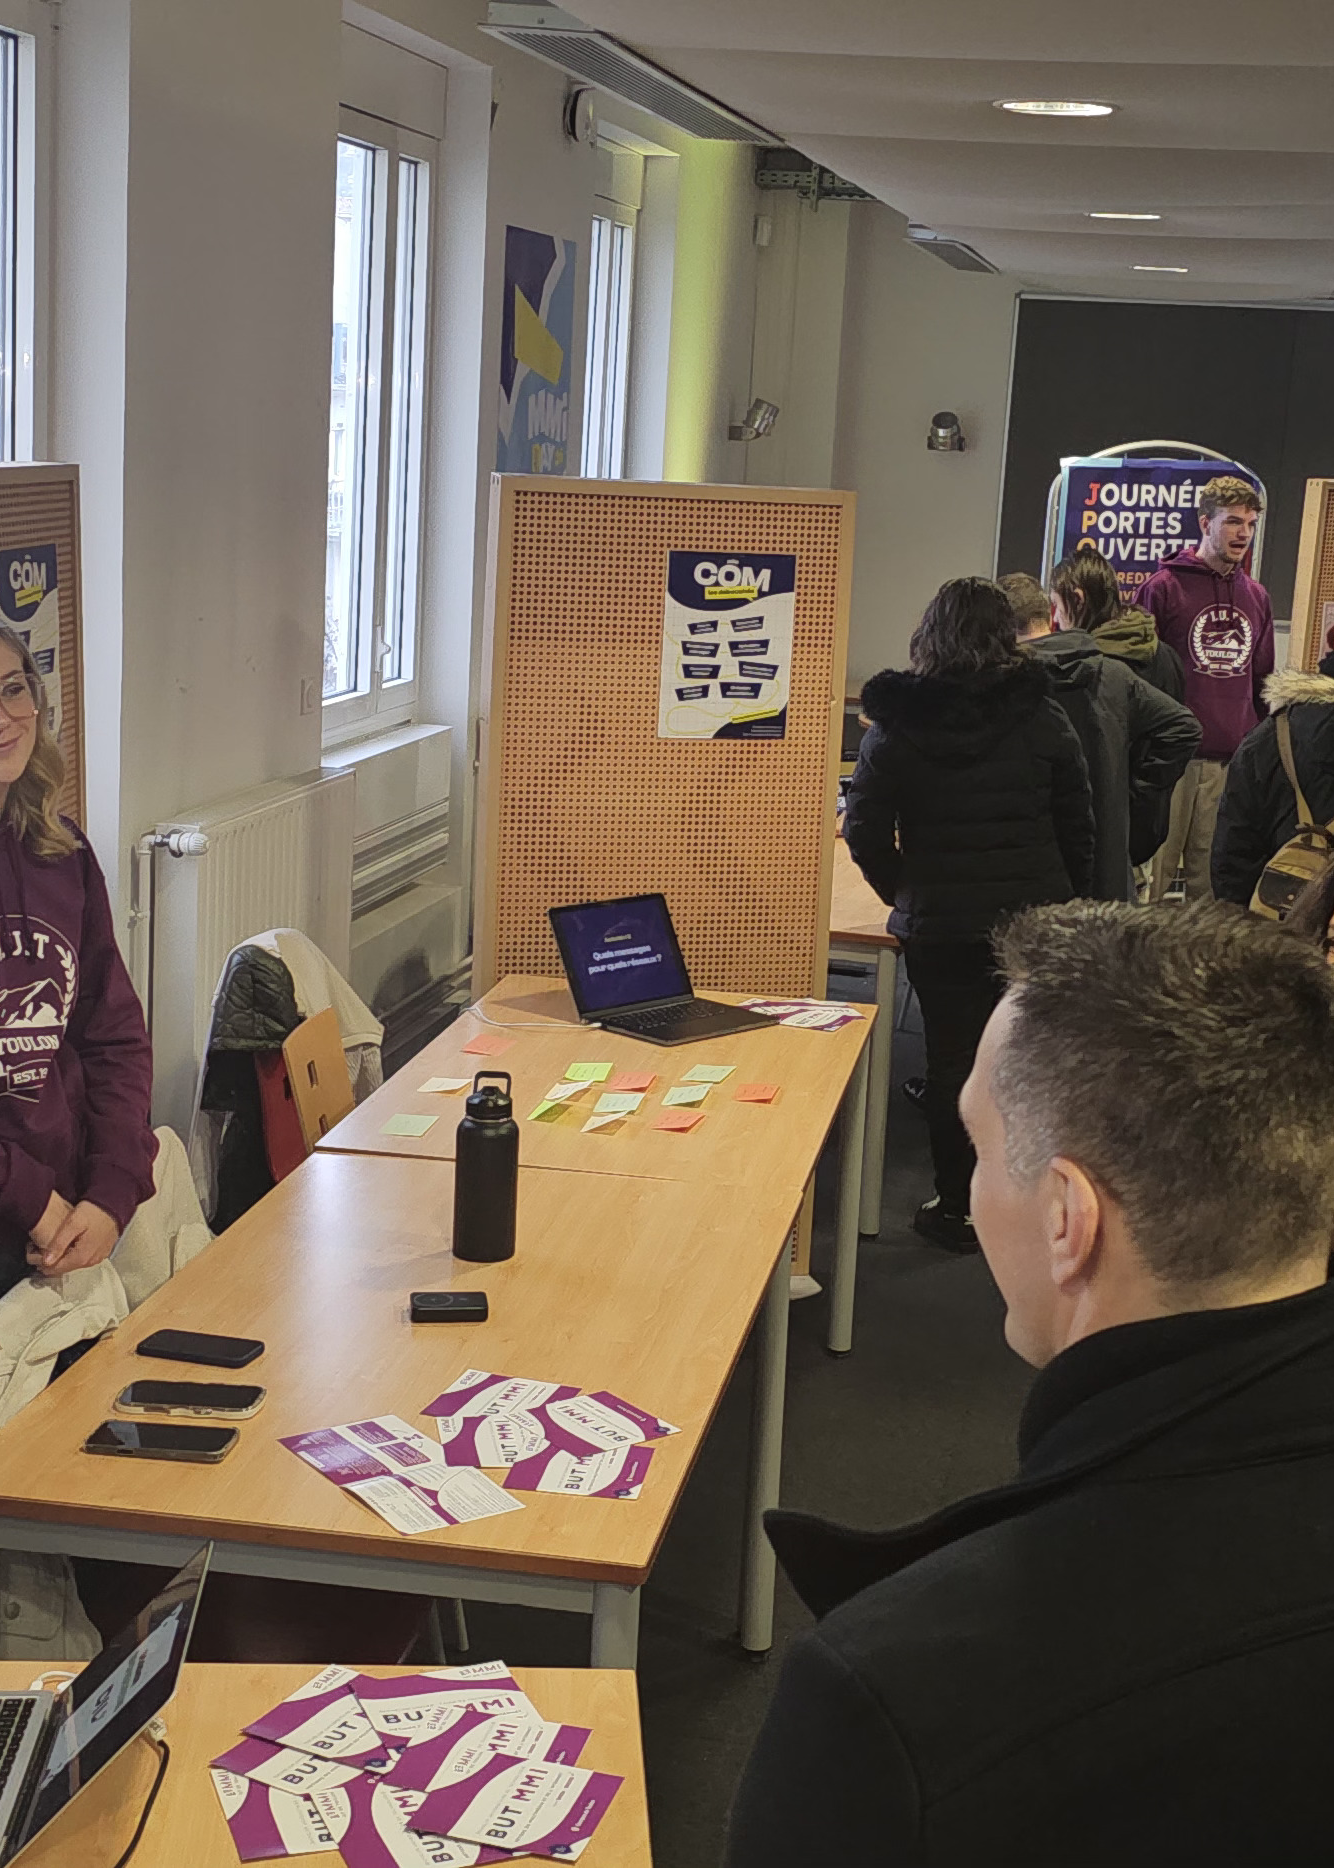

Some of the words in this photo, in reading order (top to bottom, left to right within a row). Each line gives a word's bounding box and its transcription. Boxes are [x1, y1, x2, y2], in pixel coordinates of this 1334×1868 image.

[1082, 510, 1182, 534] PORTES
[565, 1468, 587, 1490] BUT
[382, 1708, 432, 1724] BU
[312, 1720, 357, 1750] BUT
[485, 1805, 523, 1839] BUT
[510, 1768, 548, 1801] MMI
